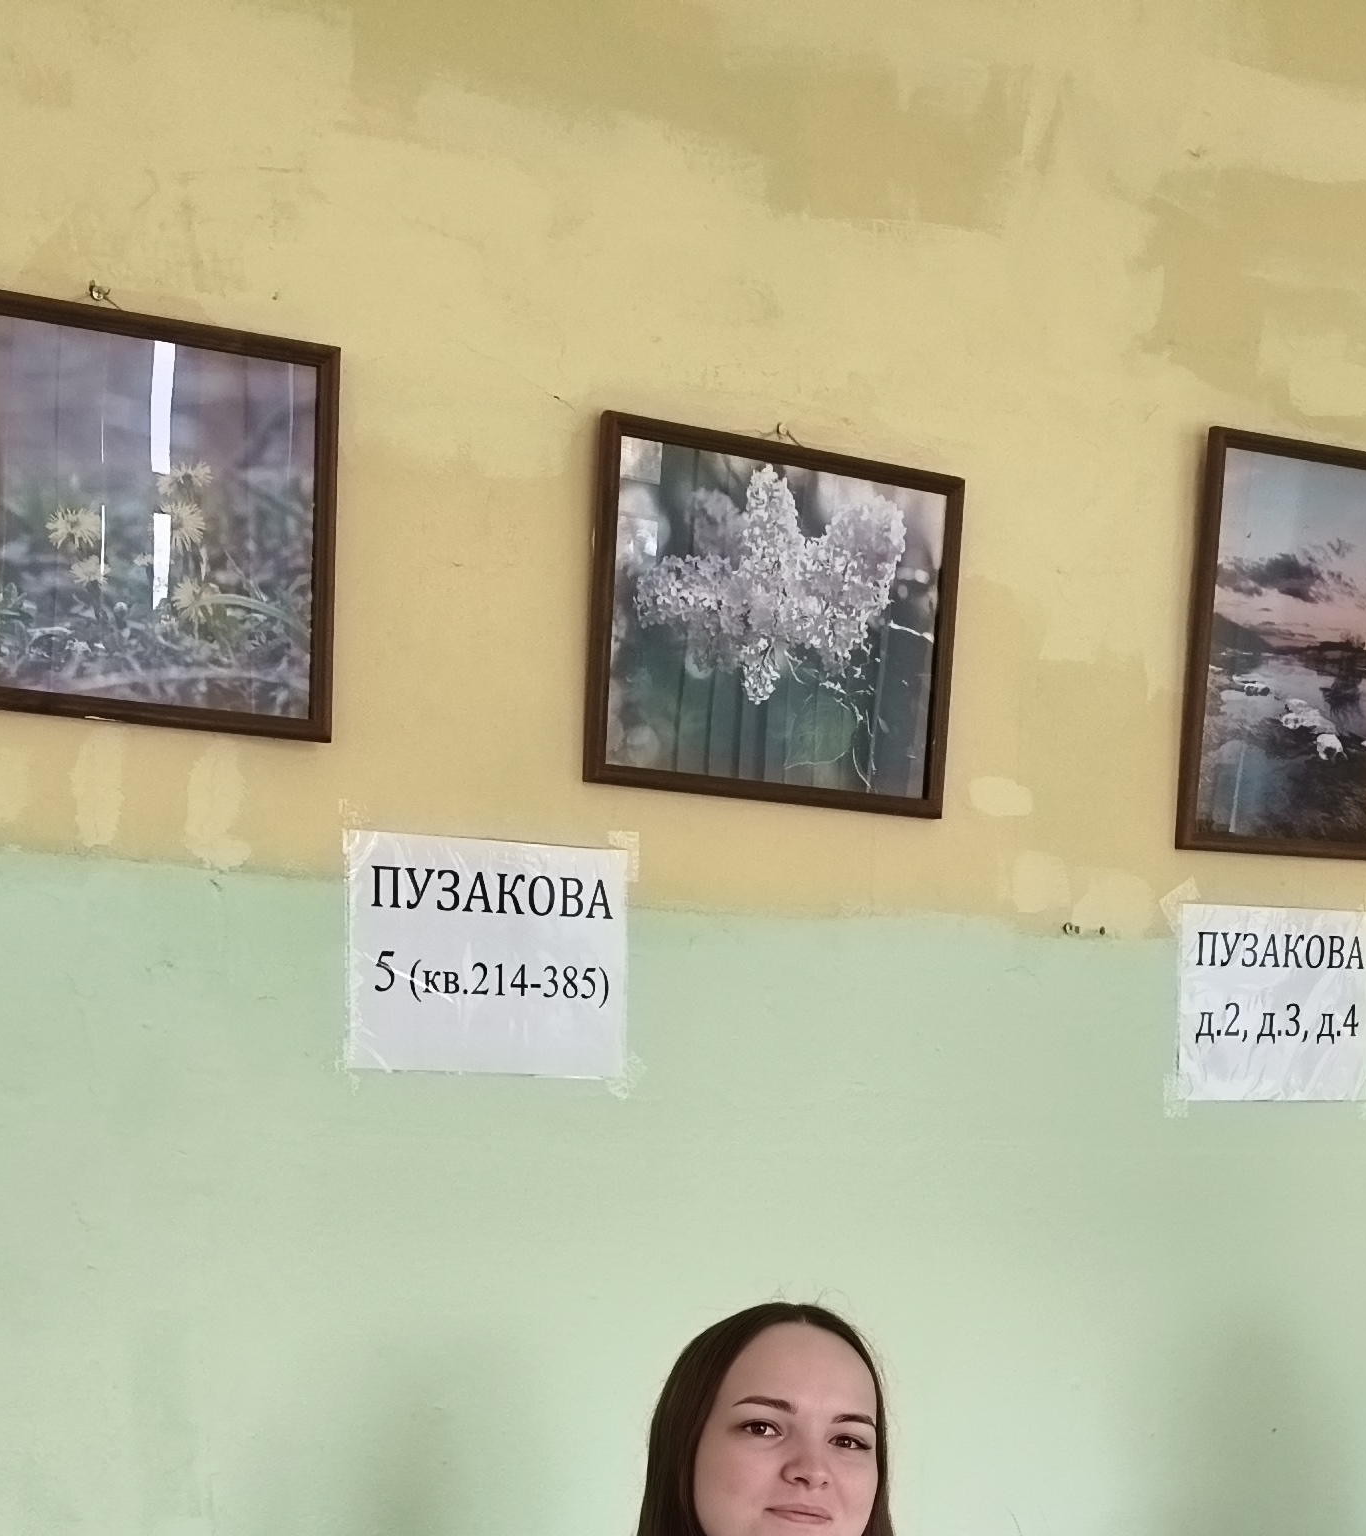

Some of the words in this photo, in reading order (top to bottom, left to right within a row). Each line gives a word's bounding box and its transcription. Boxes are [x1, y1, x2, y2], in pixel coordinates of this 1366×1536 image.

[371, 865, 614, 920] ПУЗАКОВА
[1196, 931, 1365, 970] ПУЗАКОВА
[374, 950, 395, 992] 5
[409, 959, 609, 1008] (кв.214-385)
[1195, 1002, 1248, 1044] д.2,
[1257, 1003, 1309, 1044] д.3,
[1316, 1004, 1359, 1045] д.4
